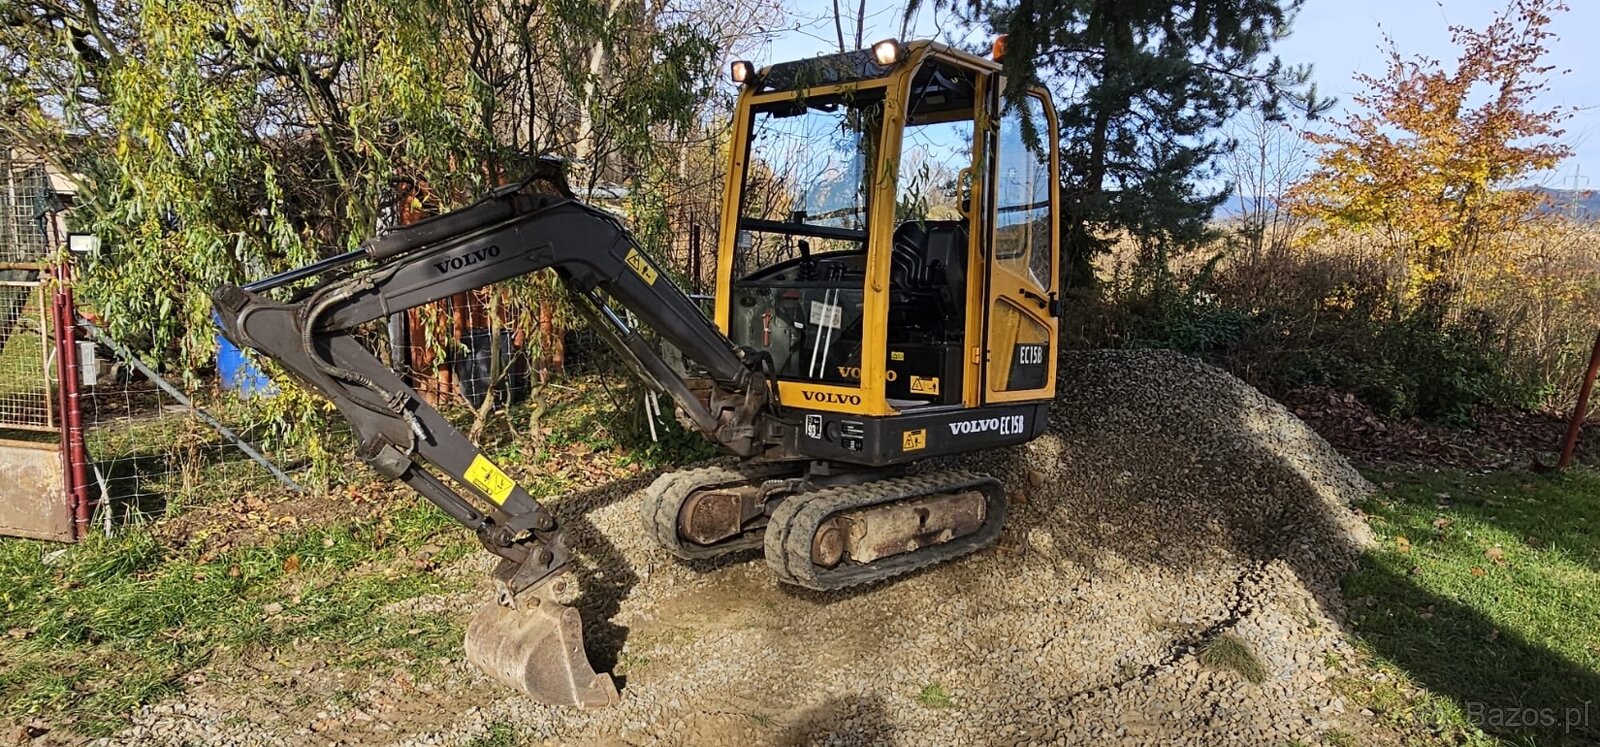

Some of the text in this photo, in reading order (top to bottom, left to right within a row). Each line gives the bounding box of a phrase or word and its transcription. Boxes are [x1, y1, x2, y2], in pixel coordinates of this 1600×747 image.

[433, 245, 500, 274] VOLVO
[1020, 346, 1042, 364] EC15B
[837, 366, 897, 381] VOO
[801, 390, 861, 405] VOLVO
[949, 415, 1024, 435] VOLVO EC15B
